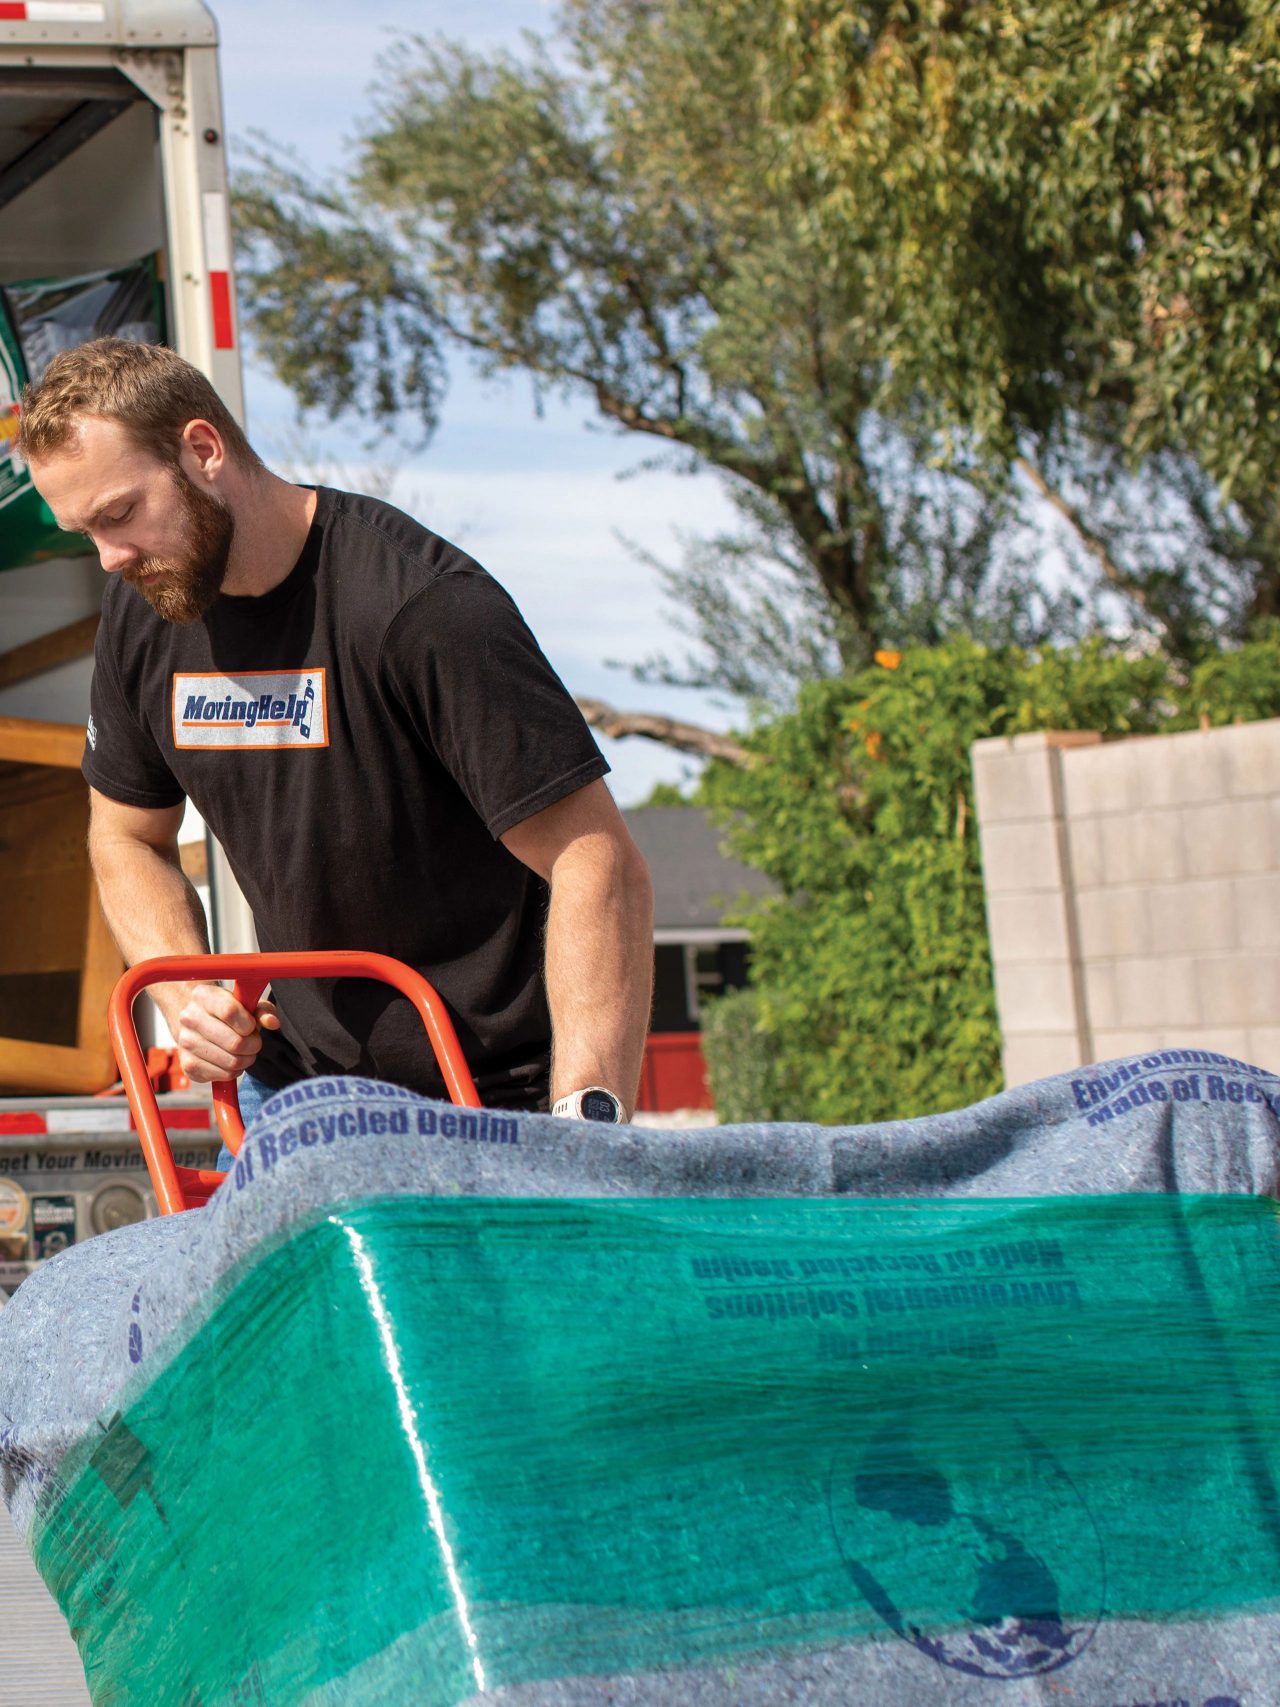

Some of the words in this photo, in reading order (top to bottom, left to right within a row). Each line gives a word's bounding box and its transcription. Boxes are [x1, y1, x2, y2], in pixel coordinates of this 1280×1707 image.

[182, 694, 307, 728] MovingHelp
[1086, 1079, 1169, 1127] Made
[1172, 1075, 1200, 1102] of
[36, 1152, 77, 1170] Your
[235, 1146, 255, 1190] of
[258, 1107, 409, 1171] Recycled
[418, 1107, 519, 1146] Denim
[796, 1254, 943, 1279] Recycled
[945, 1251, 977, 1273] of
[980, 1239, 1067, 1270] Made
[705, 1288, 859, 1322] Solutions
